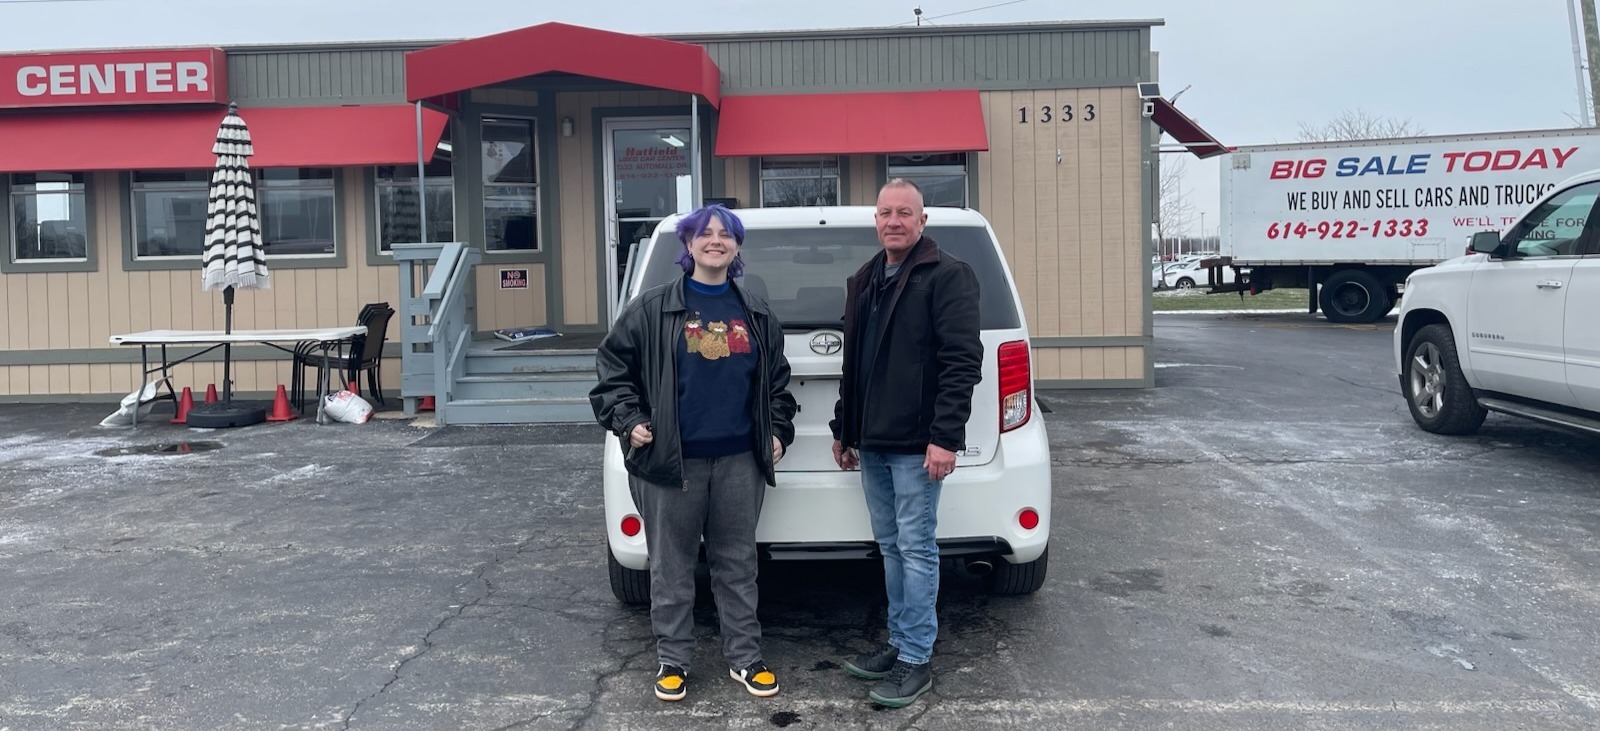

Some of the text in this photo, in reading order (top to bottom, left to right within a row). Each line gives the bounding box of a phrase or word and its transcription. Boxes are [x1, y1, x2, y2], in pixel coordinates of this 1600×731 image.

[16, 62, 208, 96] CENTER
[1019, 104, 1095, 123] 1333
[626, 147, 678, 156] Hatfield
[1270, 147, 1579, 179] BIG SALE TODAY
[1288, 192, 1307, 210] WE
[1312, 191, 1338, 209] BUY
[1343, 190, 1371, 209] AND
[1376, 189, 1409, 208] SELL
[1415, 187, 1453, 207] CARS
[1459, 186, 1489, 205] AND
[1267, 219, 1429, 240] 614-922-1333
[1453, 216, 1494, 226] WE'LL
[1555, 217, 1585, 227] FOR
[502, 279, 526, 287] SMOKING
[1472, 332, 1505, 340] SUBURBAN
